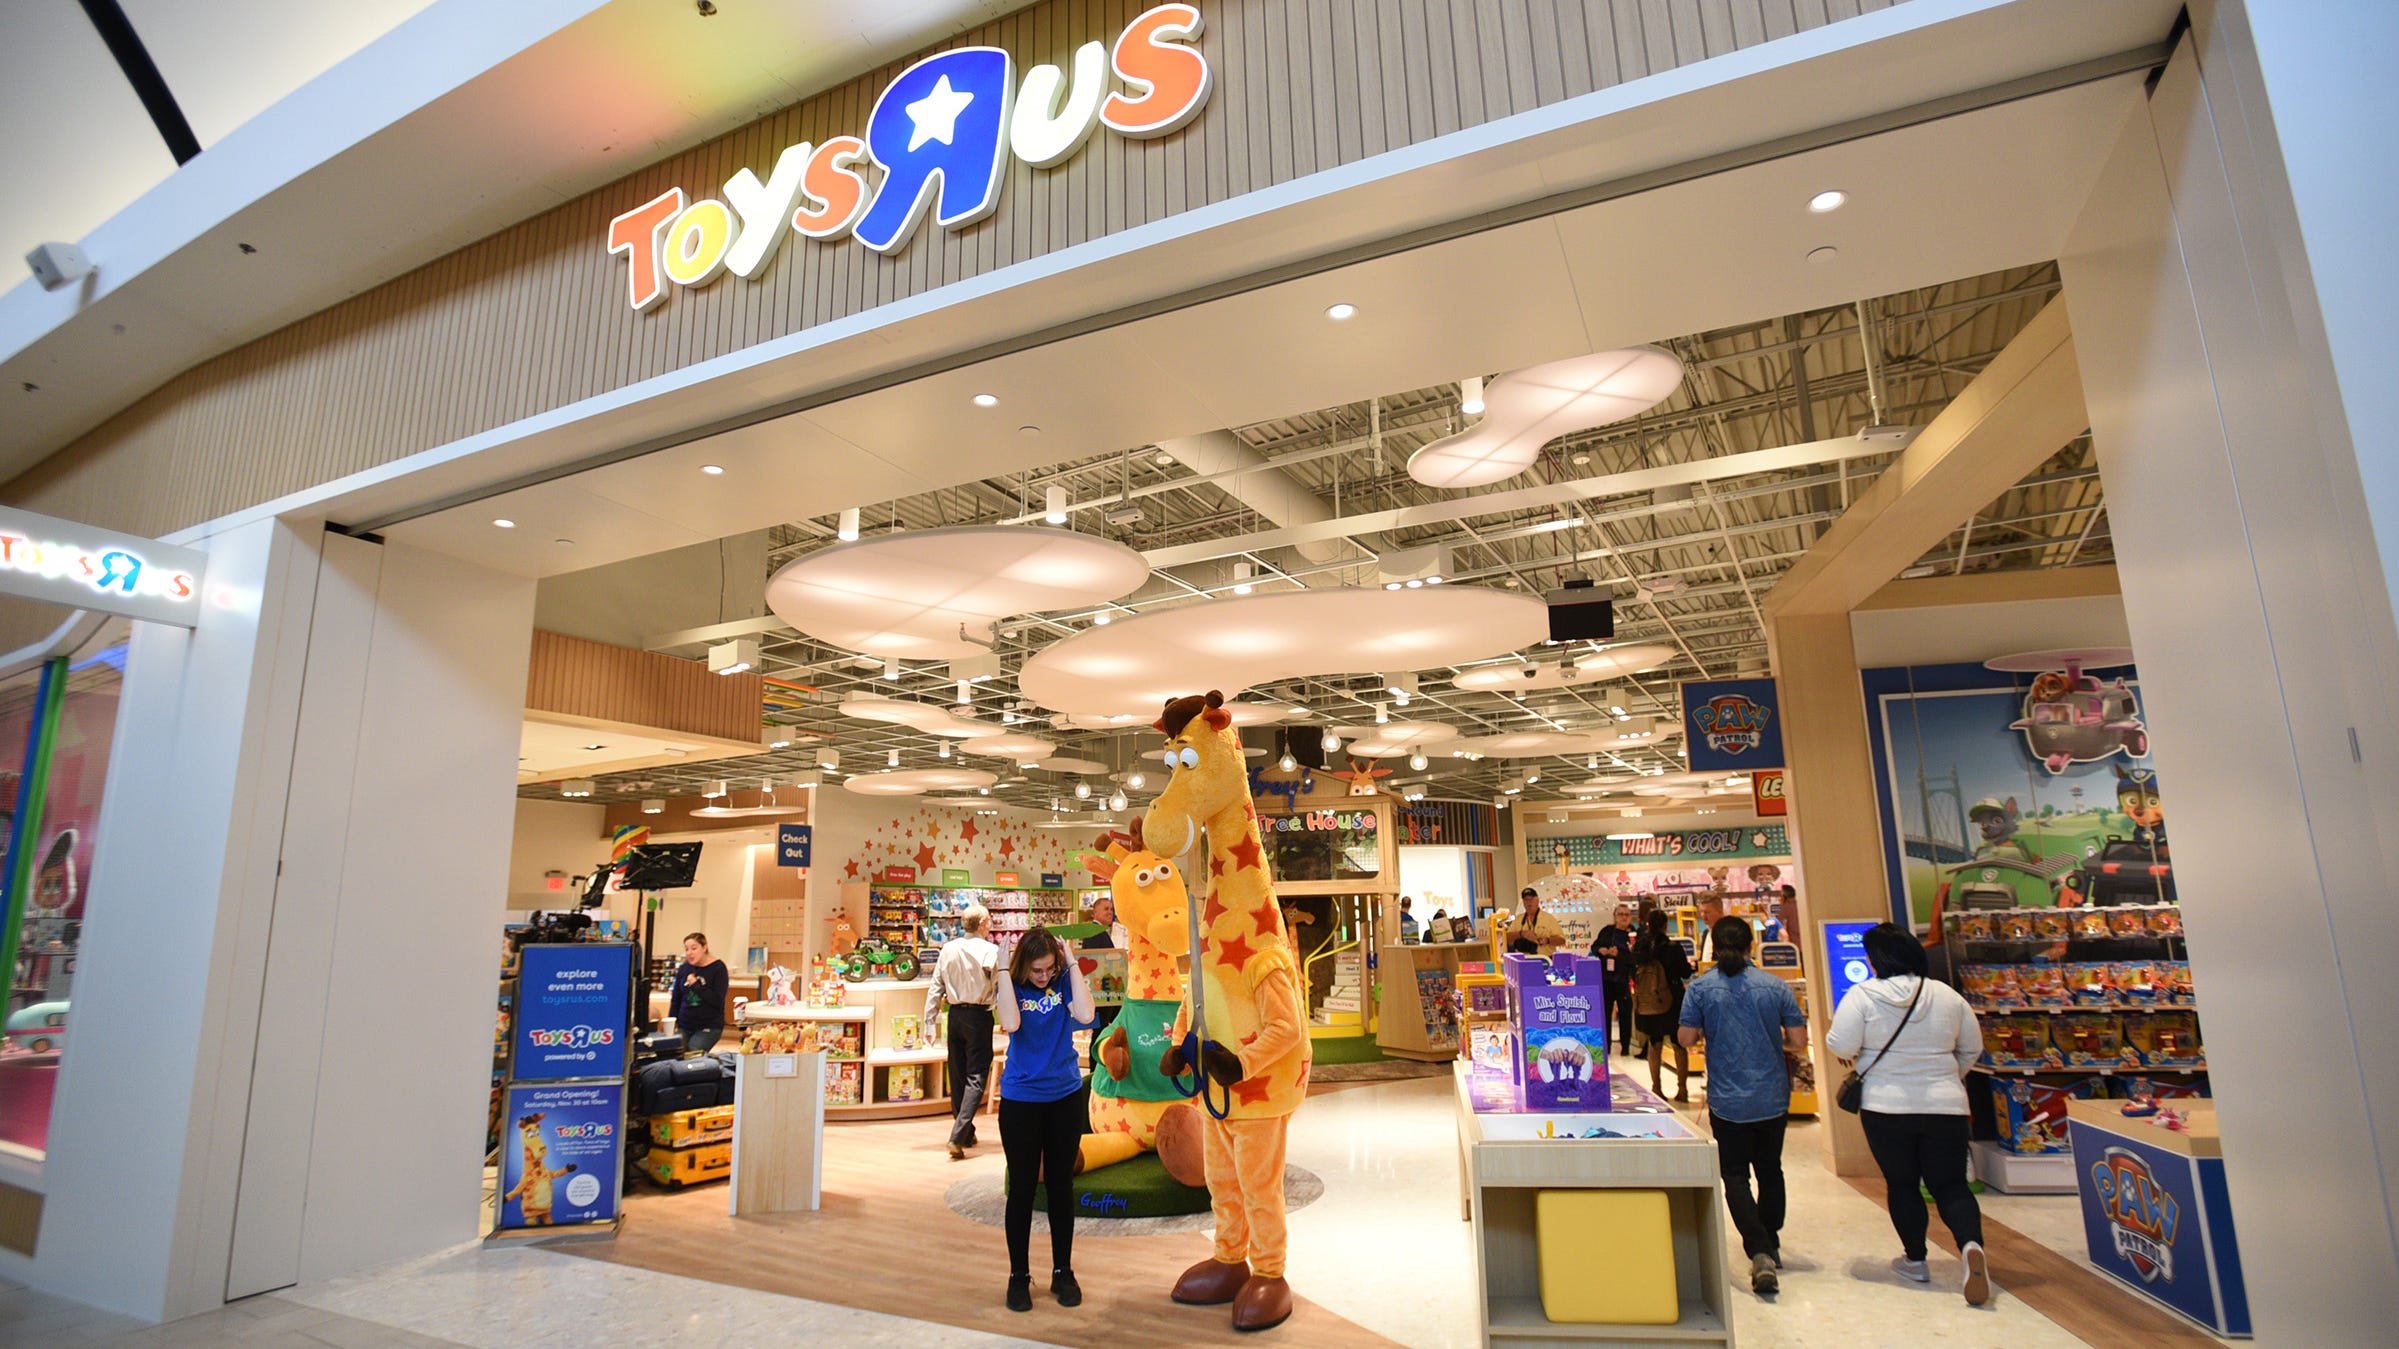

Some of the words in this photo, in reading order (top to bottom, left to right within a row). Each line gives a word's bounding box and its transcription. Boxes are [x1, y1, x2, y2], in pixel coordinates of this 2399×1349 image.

[1692, 704, 1772, 734] PAW
[1713, 734, 1755, 744] PATROL
[1760, 776, 1785, 798] LE
[781, 833, 808, 844] Check
[1620, 834, 1683, 856] WHAT'S
[1687, 830, 1742, 854] COOL!
[785, 848, 803, 858] Out
[1423, 891, 1454, 908] Toys
[556, 969, 598, 980] explore
[542, 995, 608, 1006] toysrus.com
[1539, 1010, 1557, 1022] and
[2091, 1161, 2180, 1246] PAW
[2117, 1231, 2166, 1266] PATROL
